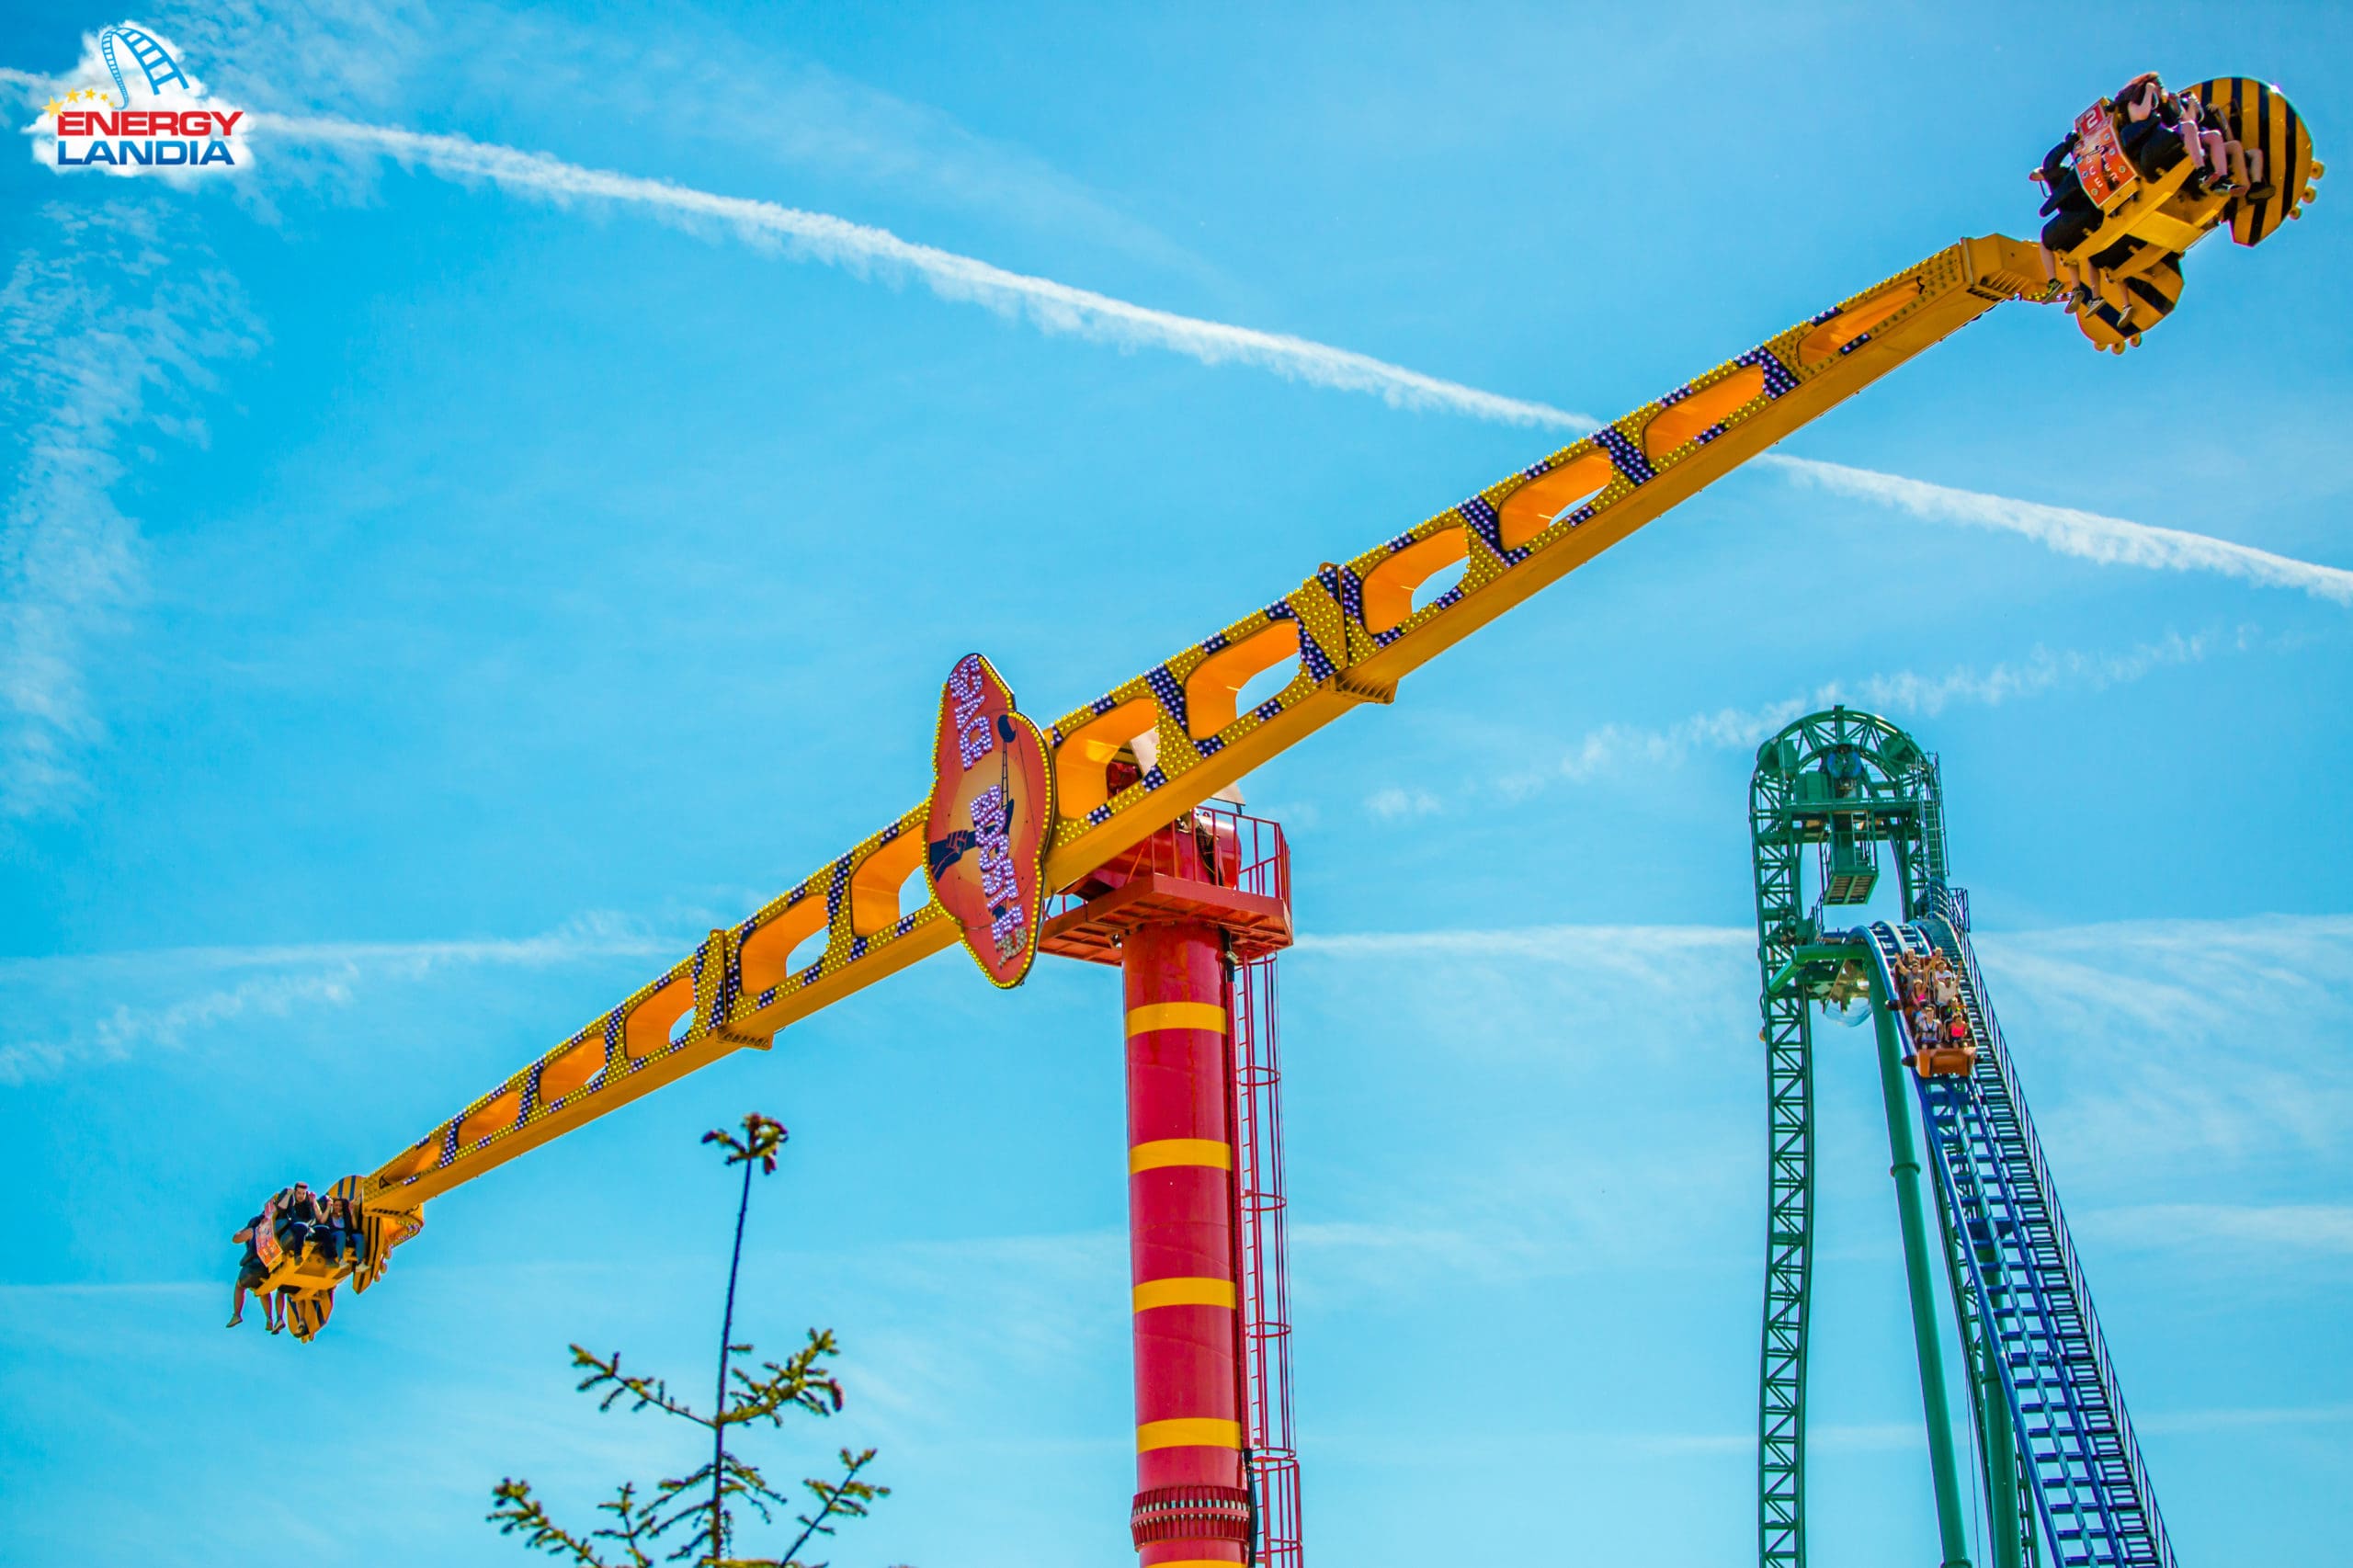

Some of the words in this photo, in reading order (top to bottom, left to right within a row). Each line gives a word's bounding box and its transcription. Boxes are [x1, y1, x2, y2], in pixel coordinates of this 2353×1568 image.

[2086, 108, 2098, 130] 2
[948, 653, 994, 772] SPACE
[971, 784, 1028, 969] BOOSTER
